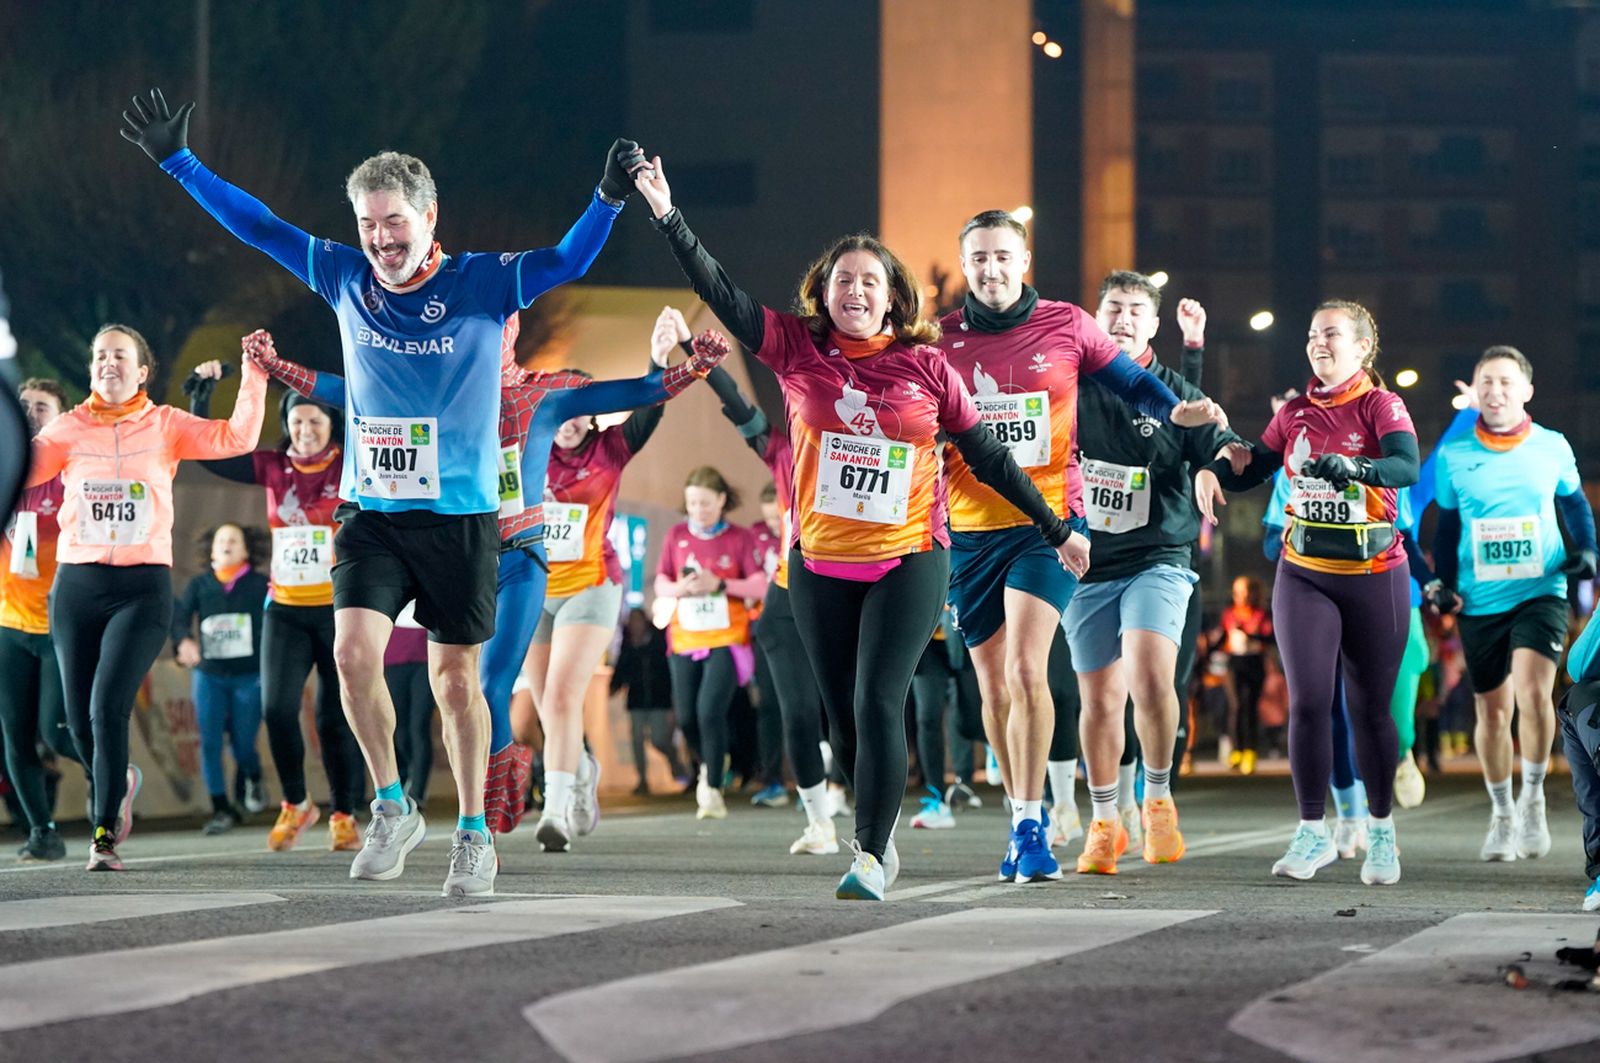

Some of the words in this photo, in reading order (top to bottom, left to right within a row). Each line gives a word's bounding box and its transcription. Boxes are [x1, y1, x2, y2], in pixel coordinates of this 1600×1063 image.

[371, 331, 455, 355] BULEVAR
[980, 412, 991, 421] AN
[983, 402, 1007, 411] NOCHE
[369, 425, 392, 435] NOCHE
[393, 427, 403, 436] DE
[850, 412, 875, 436] 43
[361, 436, 375, 445] SAN
[841, 443, 869, 456] NOCHE
[870, 447, 882, 457] DE
[369, 447, 418, 472] 7407
[830, 451, 849, 463] SAN
[849, 454, 880, 467] ANTÓN
[840, 465, 890, 494] 6771
[1091, 486, 1134, 512] 1681
[91, 502, 136, 522] 6413
[1301, 500, 1350, 523] 1339
[1483, 540, 1532, 560] 13973
